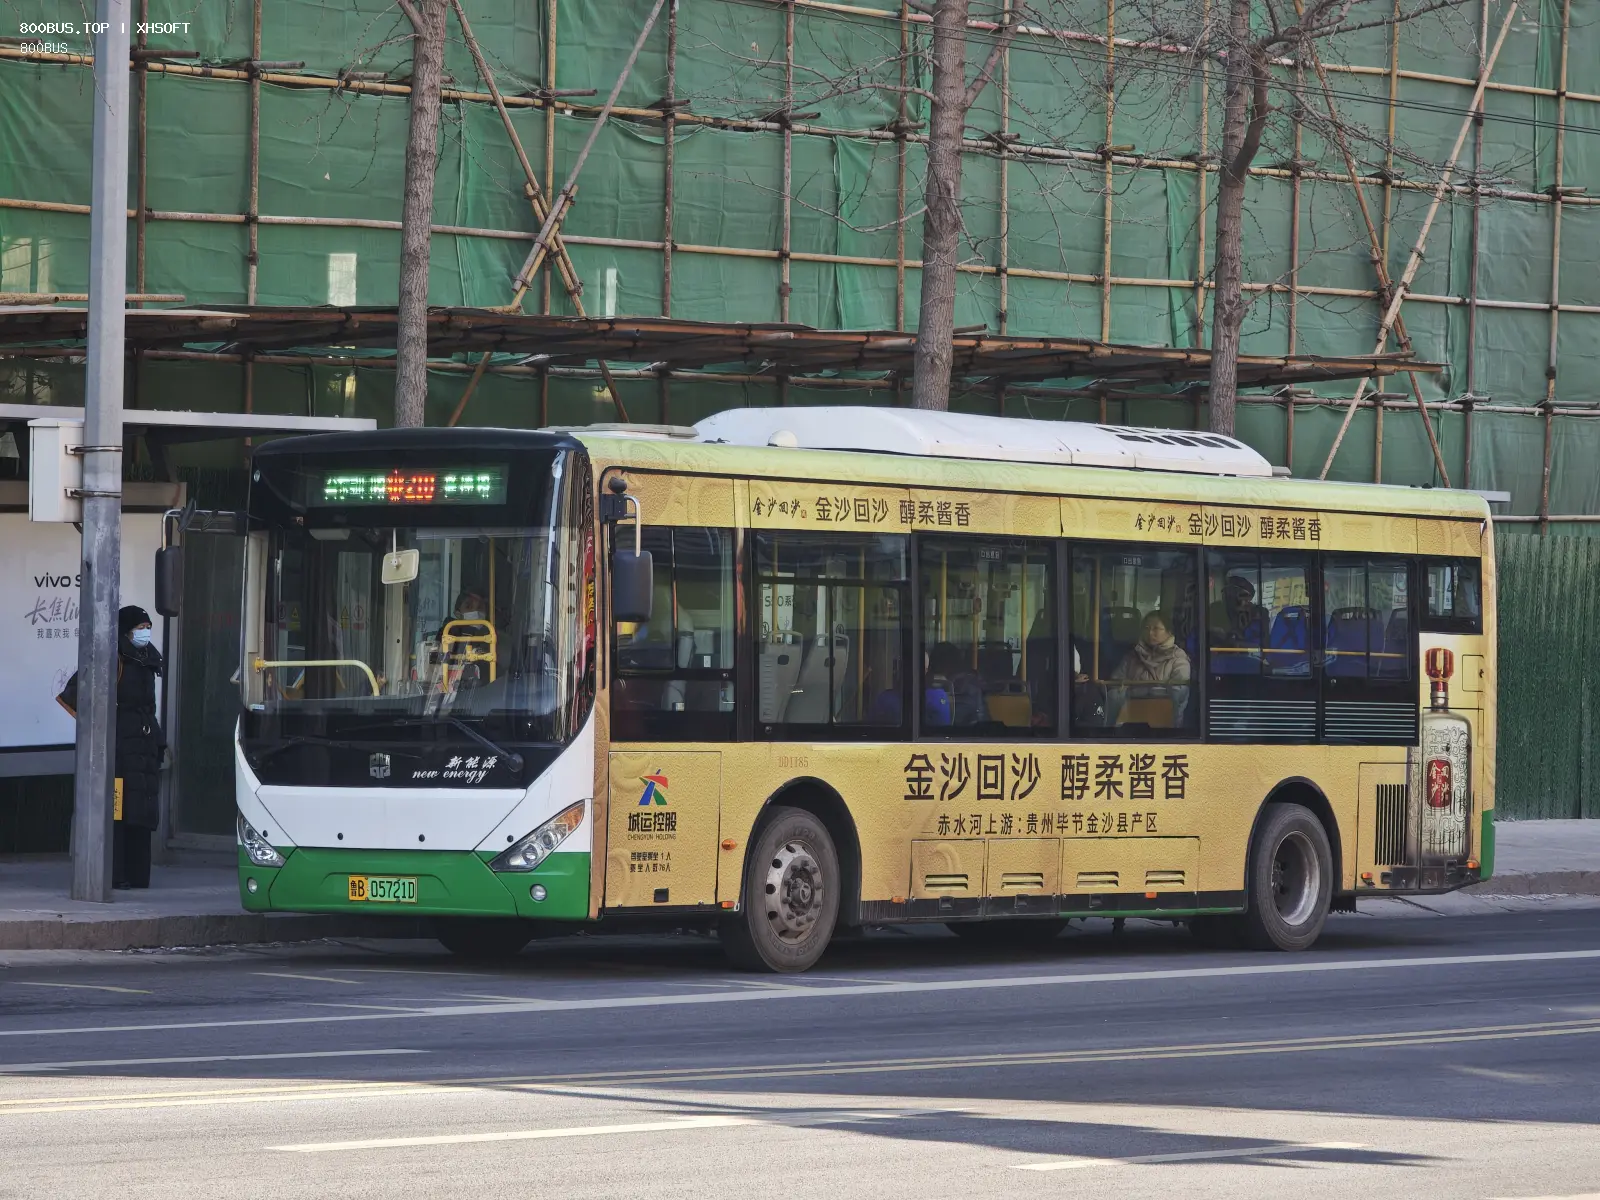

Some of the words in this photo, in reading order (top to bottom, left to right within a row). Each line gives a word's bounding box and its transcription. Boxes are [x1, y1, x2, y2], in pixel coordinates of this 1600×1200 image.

[815, 496, 889, 523] 金沙回沙
[899, 499, 971, 527] 醇柔酱香
[1187, 512, 1252, 538] 金沙回沙
[1259, 516, 1322, 541] 醇柔酱香
[34, 572, 71, 588] vivo
[37, 628, 70, 639] 我喜欢我
[445, 755, 498, 769] 新能源
[412, 770, 440, 780] new
[442, 768, 490, 784] energy
[903, 752, 1042, 801] 金沙回沙
[1061, 752, 1190, 800] 醇柔酱香
[628, 812, 677, 832] 城运控股
